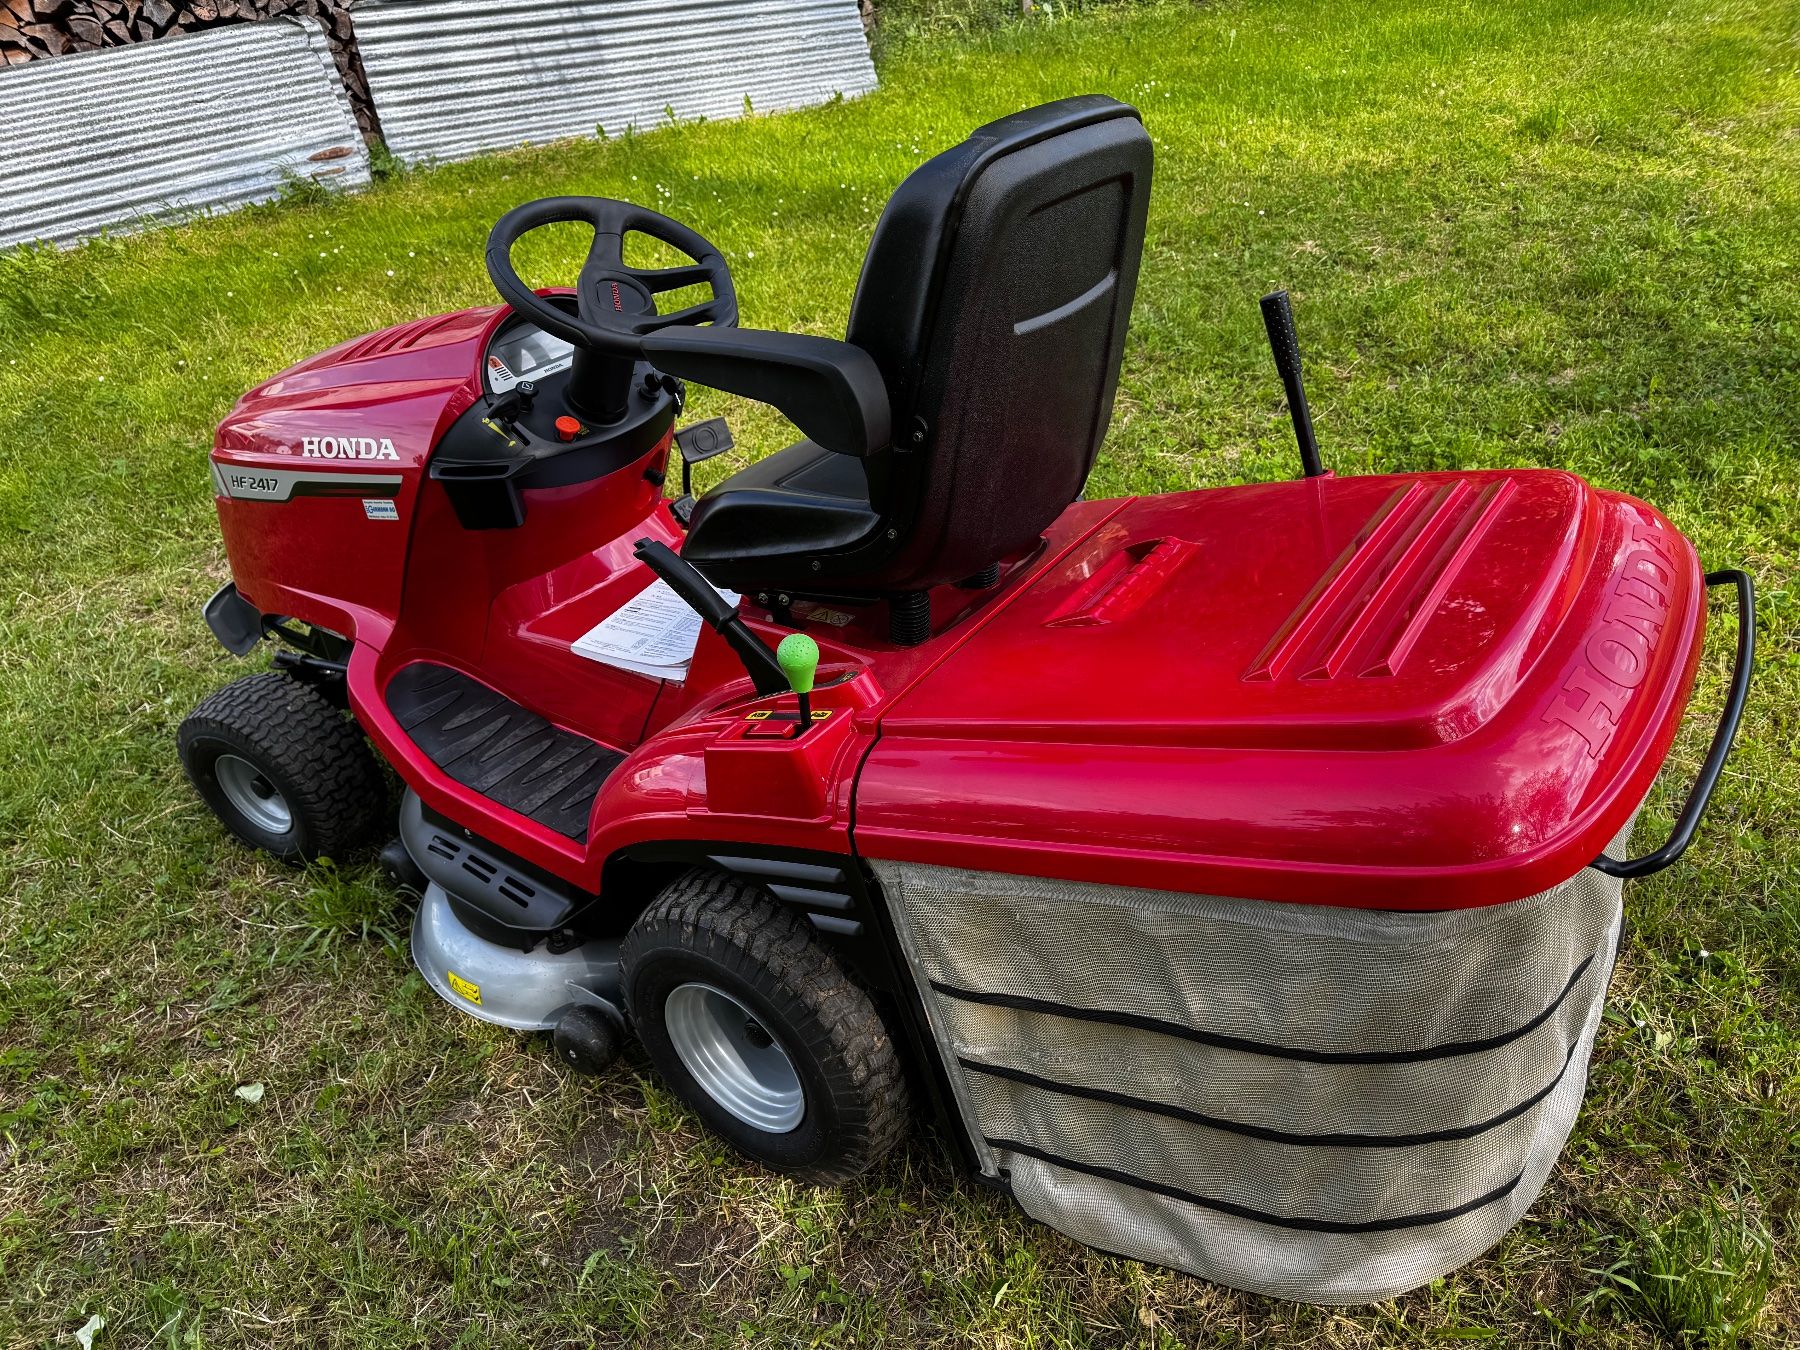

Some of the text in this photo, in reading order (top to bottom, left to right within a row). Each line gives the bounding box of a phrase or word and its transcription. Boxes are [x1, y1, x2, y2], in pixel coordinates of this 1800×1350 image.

[611, 281, 623, 312] HONDA
[543, 363, 564, 374] HONDA
[301, 436, 400, 461] HONDA
[230, 475, 279, 493] HF 2417
[1540, 523, 1680, 760] HONDA
